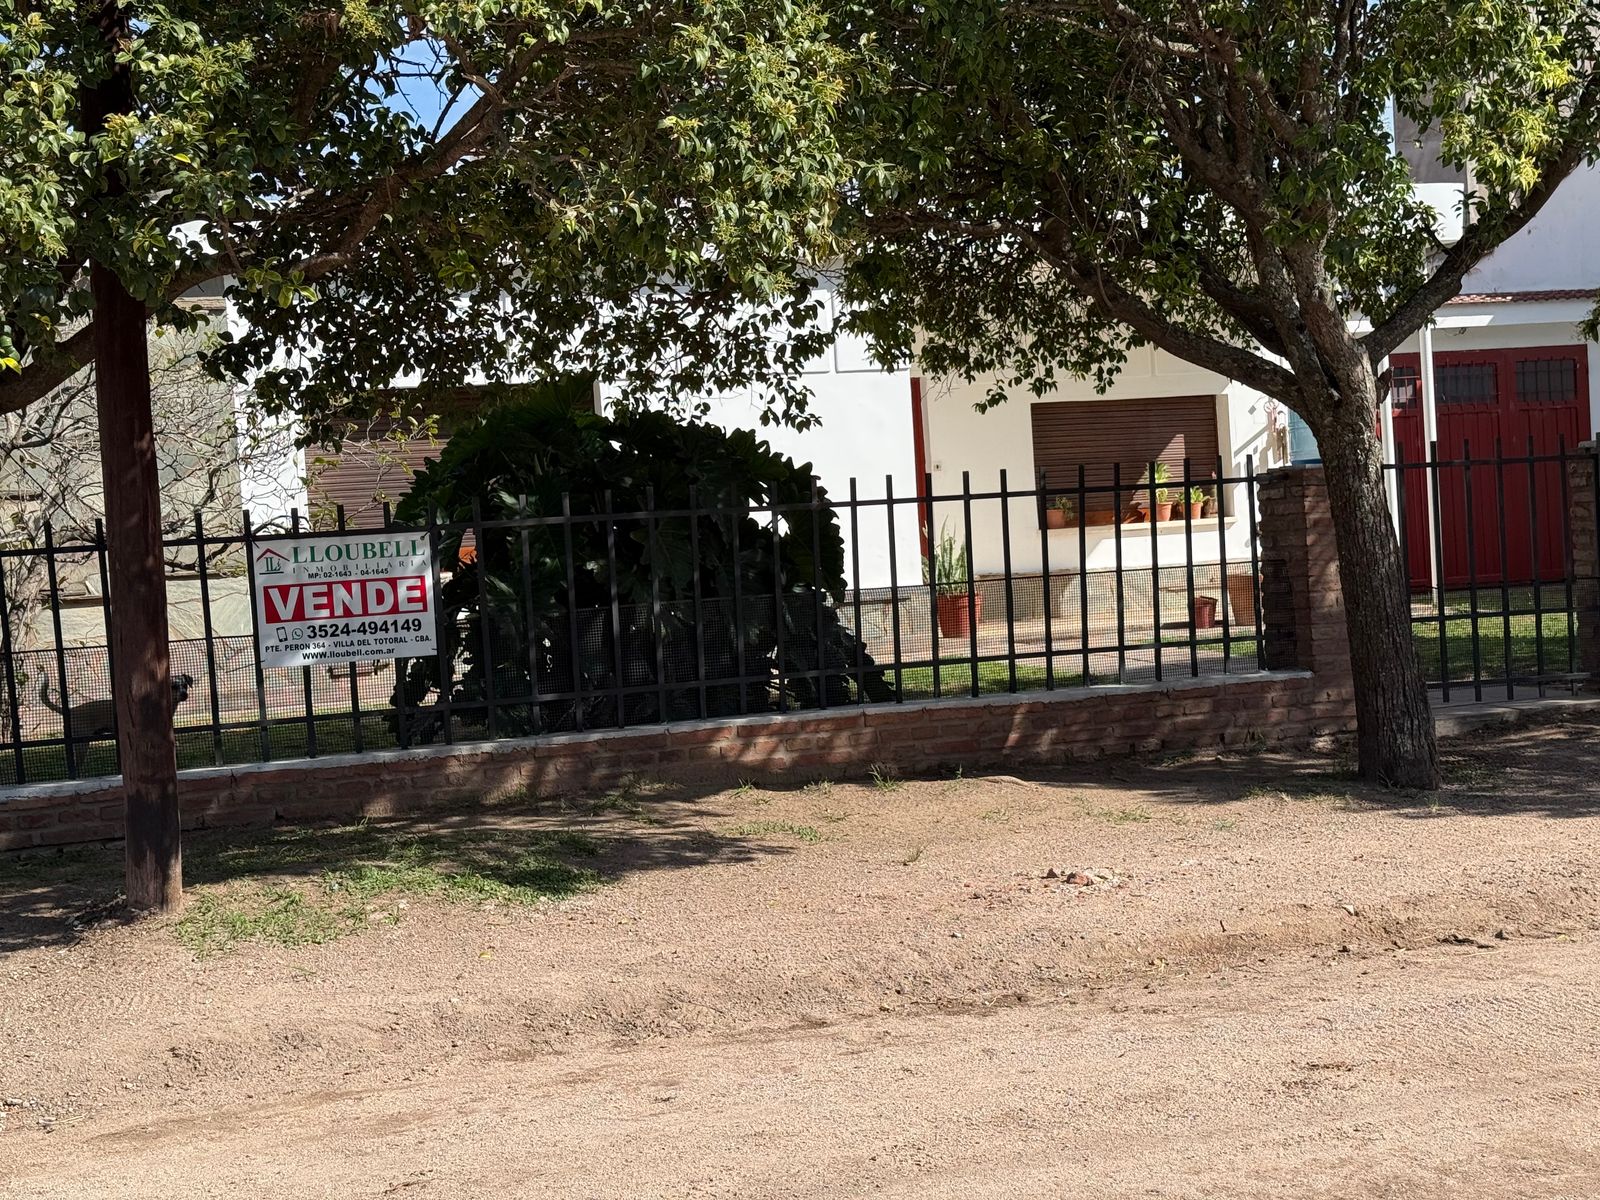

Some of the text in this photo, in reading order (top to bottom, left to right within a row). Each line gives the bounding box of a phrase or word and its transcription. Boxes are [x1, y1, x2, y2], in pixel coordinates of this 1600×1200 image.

[292, 540, 425, 564] LLOUBELL
[292, 560, 427, 574] INMOBILIARIA
[360, 568, 389, 576] 04-1645
[268, 578, 424, 621] VENDE
[307, 618, 422, 639] 3524-494149
[265, 645, 282, 653] PTE.
[284, 643, 311, 652] PERON
[312, 642, 326, 650] 364
[333, 640, 355, 648] VILLA
[357, 638, 371, 647] DEL
[373, 636, 408, 646] TOTORAL
[414, 635, 432, 643] CBA.
[302, 648, 395, 660] www.lloubell.com.ar
